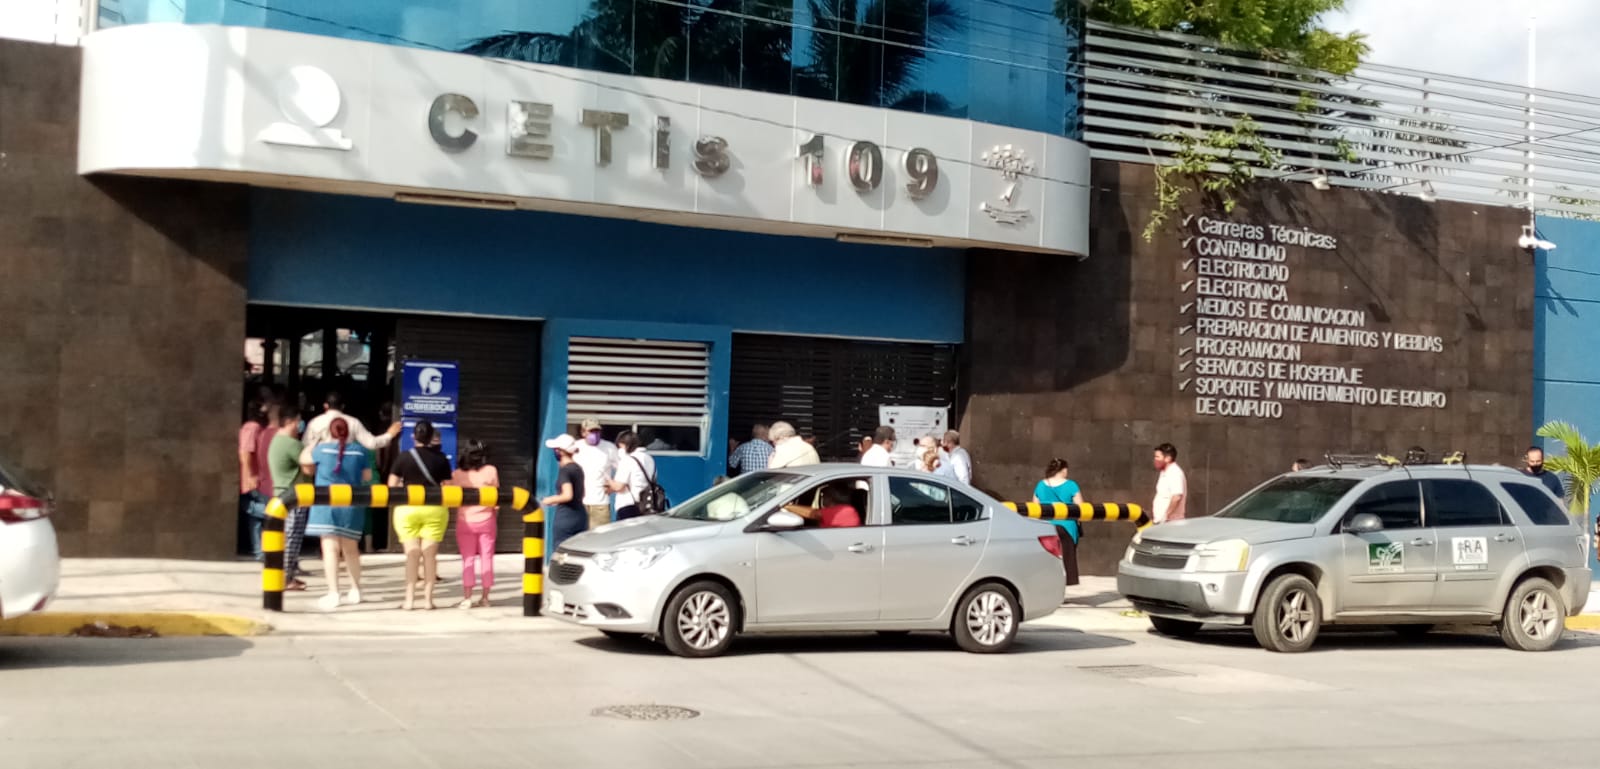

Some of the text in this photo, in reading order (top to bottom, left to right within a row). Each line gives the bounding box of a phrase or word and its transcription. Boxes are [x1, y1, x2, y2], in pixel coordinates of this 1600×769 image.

[797, 132, 939, 200] 109
[1198, 216, 1337, 250] Carreras Técnicas:
[1197, 238, 1286, 262] CONTABILIDAD
[1198, 259, 1289, 282] ELECTRICIDAD
[1197, 278, 1288, 302] ELECTRONICA
[1196, 298, 1365, 326] MEDIOS DE COMUNICACION
[1196, 318, 1443, 352] PREPARACION DE ALIMENTOS Y BEBIDAS
[1196, 338, 1301, 361] PROGRAMACION
[1196, 358, 1363, 384] SERVICIOS DE HOSPEDAJE
[1196, 378, 1446, 408] SOPORTE Y MANTENIMIENTO DE EQUIPO
[1196, 398, 1282, 418] DE COMPUTO
